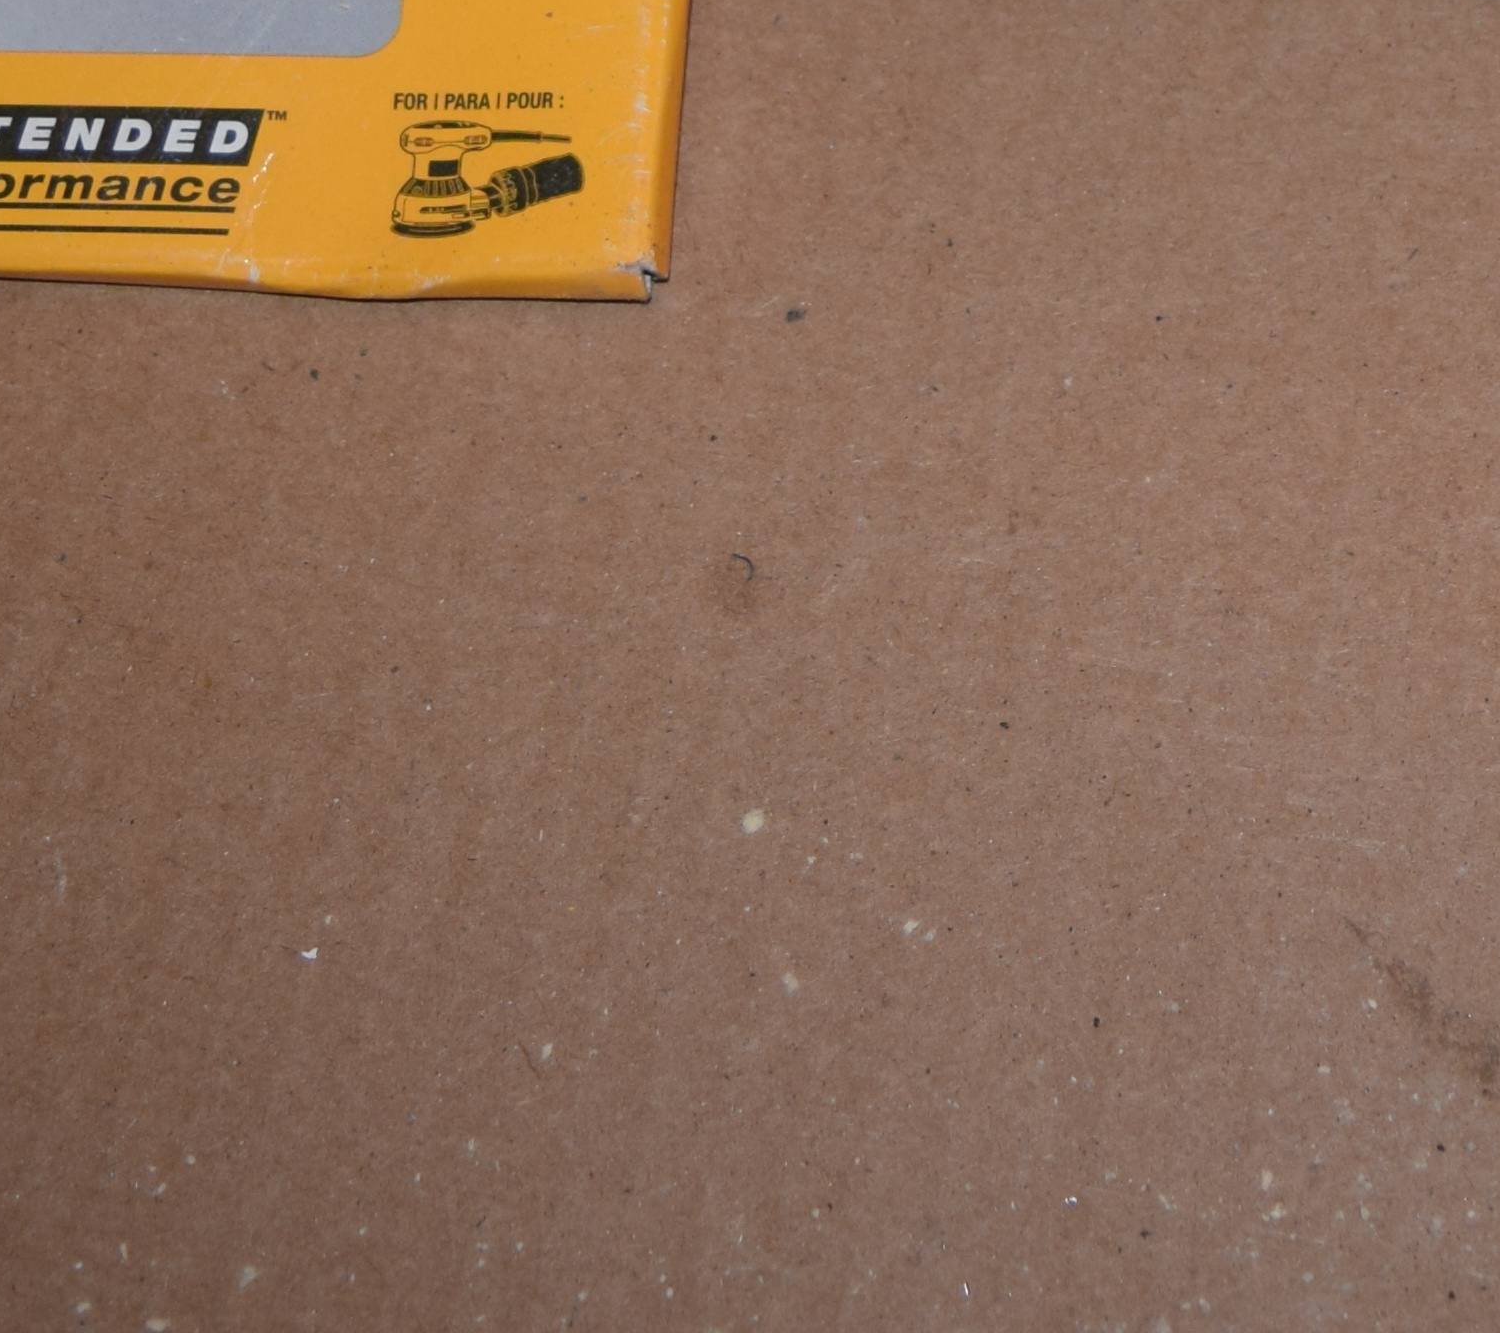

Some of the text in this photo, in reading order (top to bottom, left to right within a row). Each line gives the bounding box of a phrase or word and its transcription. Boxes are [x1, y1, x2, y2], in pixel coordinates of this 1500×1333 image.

[393, 92, 428, 110] FOR
[444, 92, 491, 110] PARA
[506, 92, 554, 109] POUR
